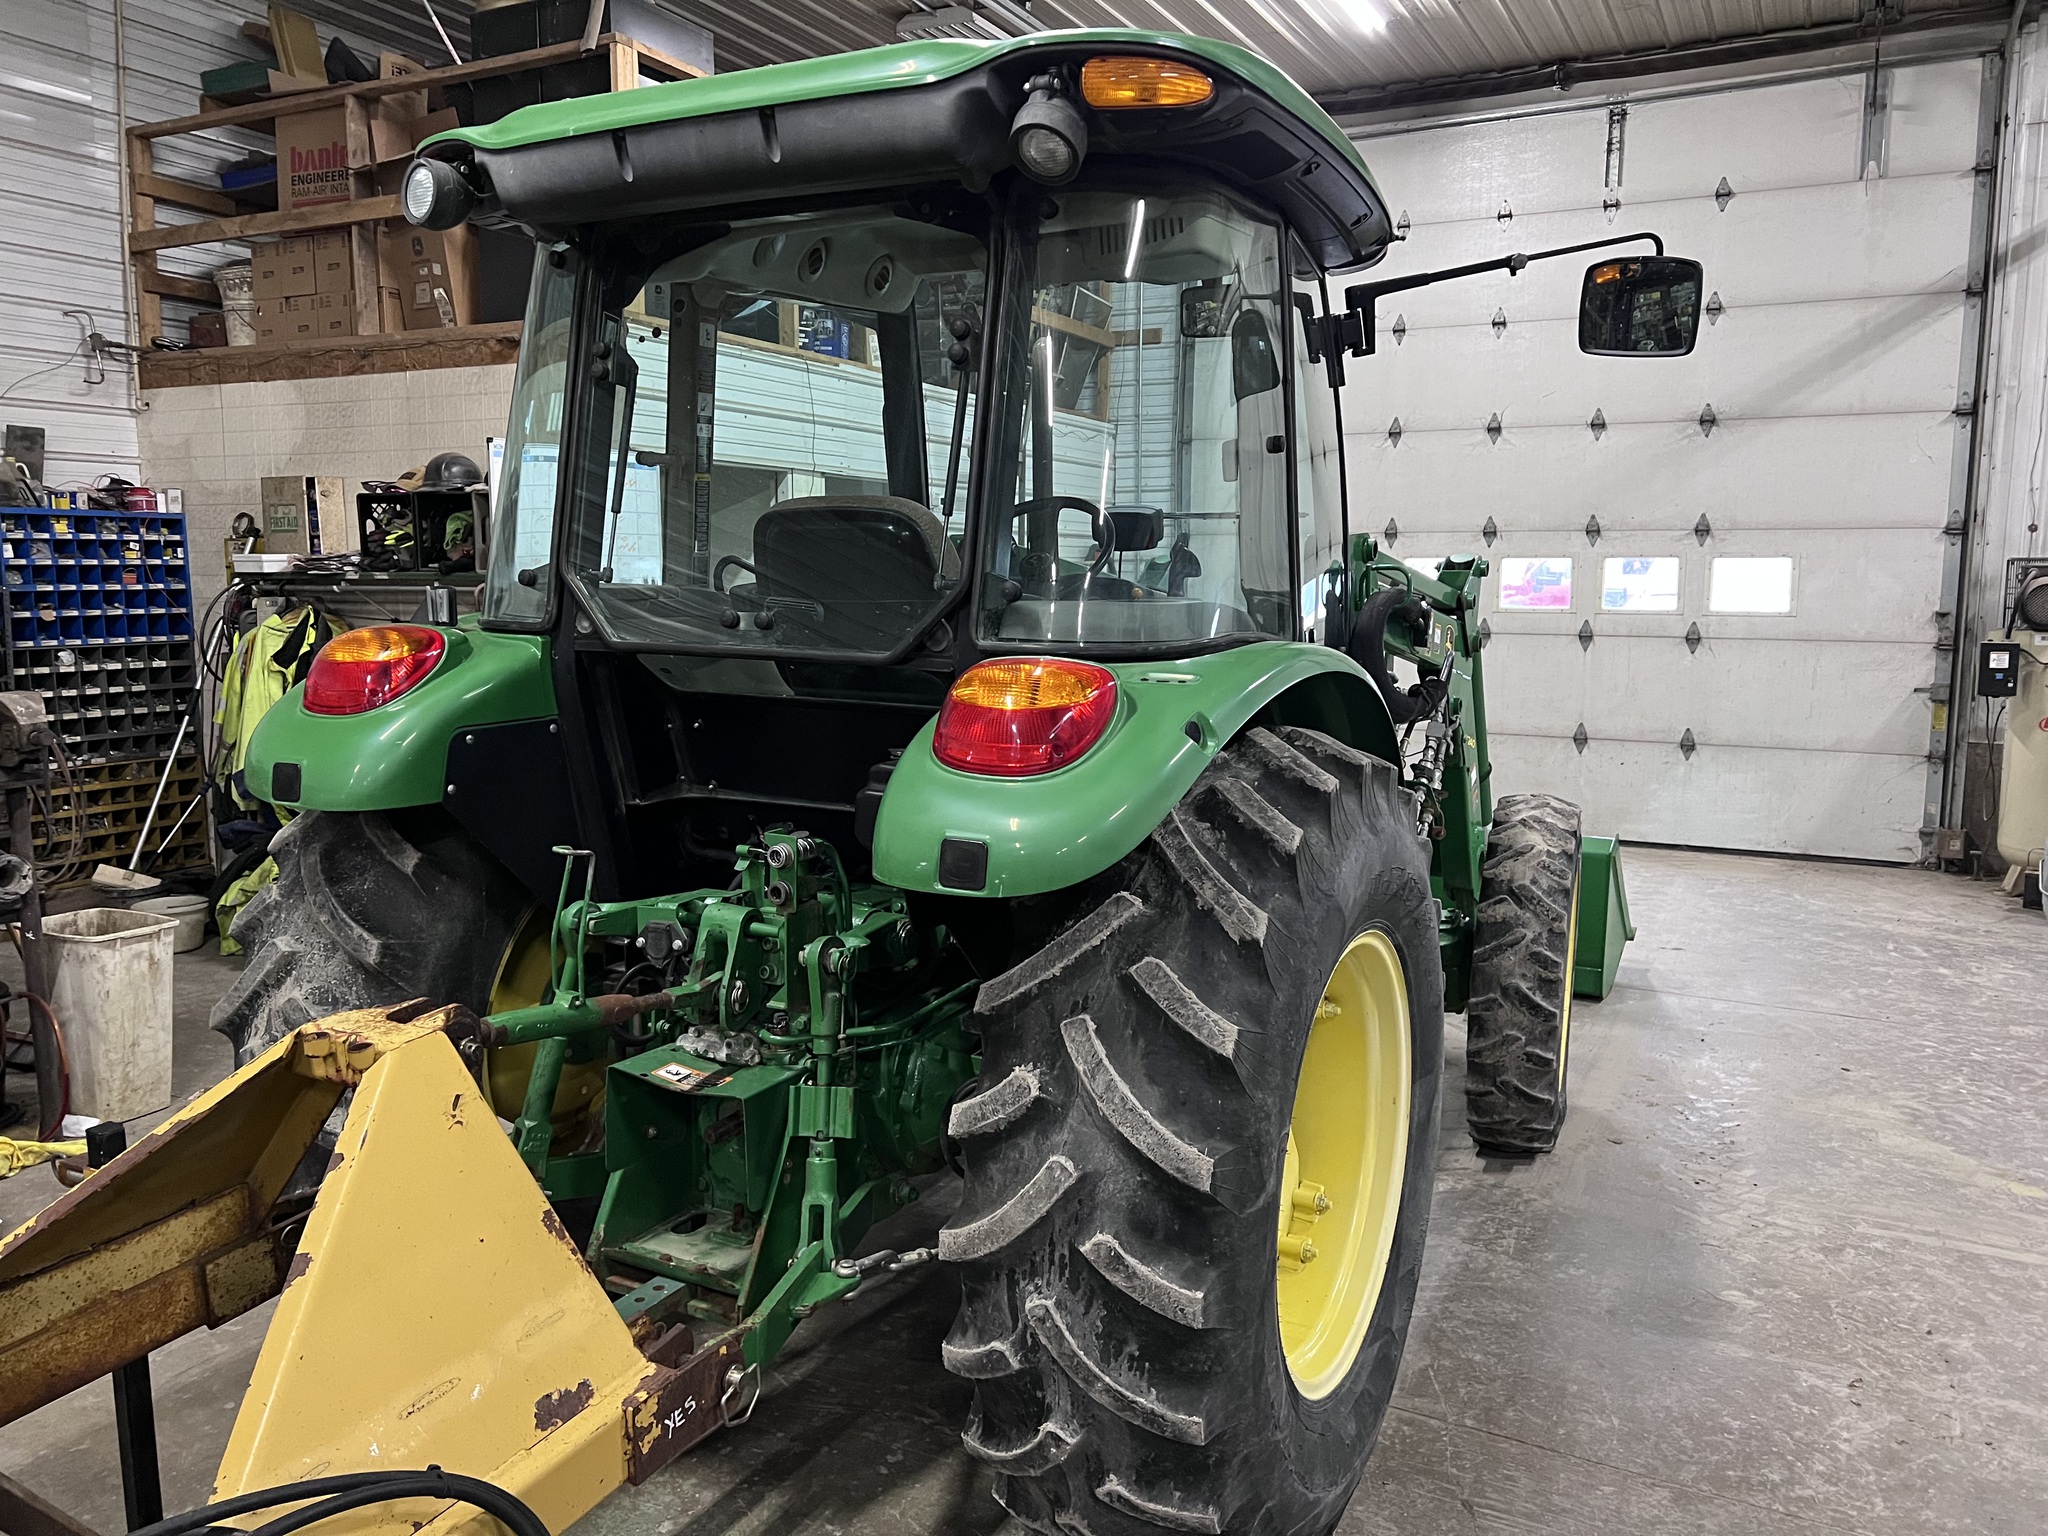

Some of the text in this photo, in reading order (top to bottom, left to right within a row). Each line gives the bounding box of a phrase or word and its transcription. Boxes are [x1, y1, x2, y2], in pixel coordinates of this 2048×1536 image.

[290, 141, 349, 174] bank
[291, 169, 349, 187] ENGINEERE
[330, 182, 350, 194] INTA
[287, 516, 298, 528] AID
[664, 1395, 696, 1439] YES
